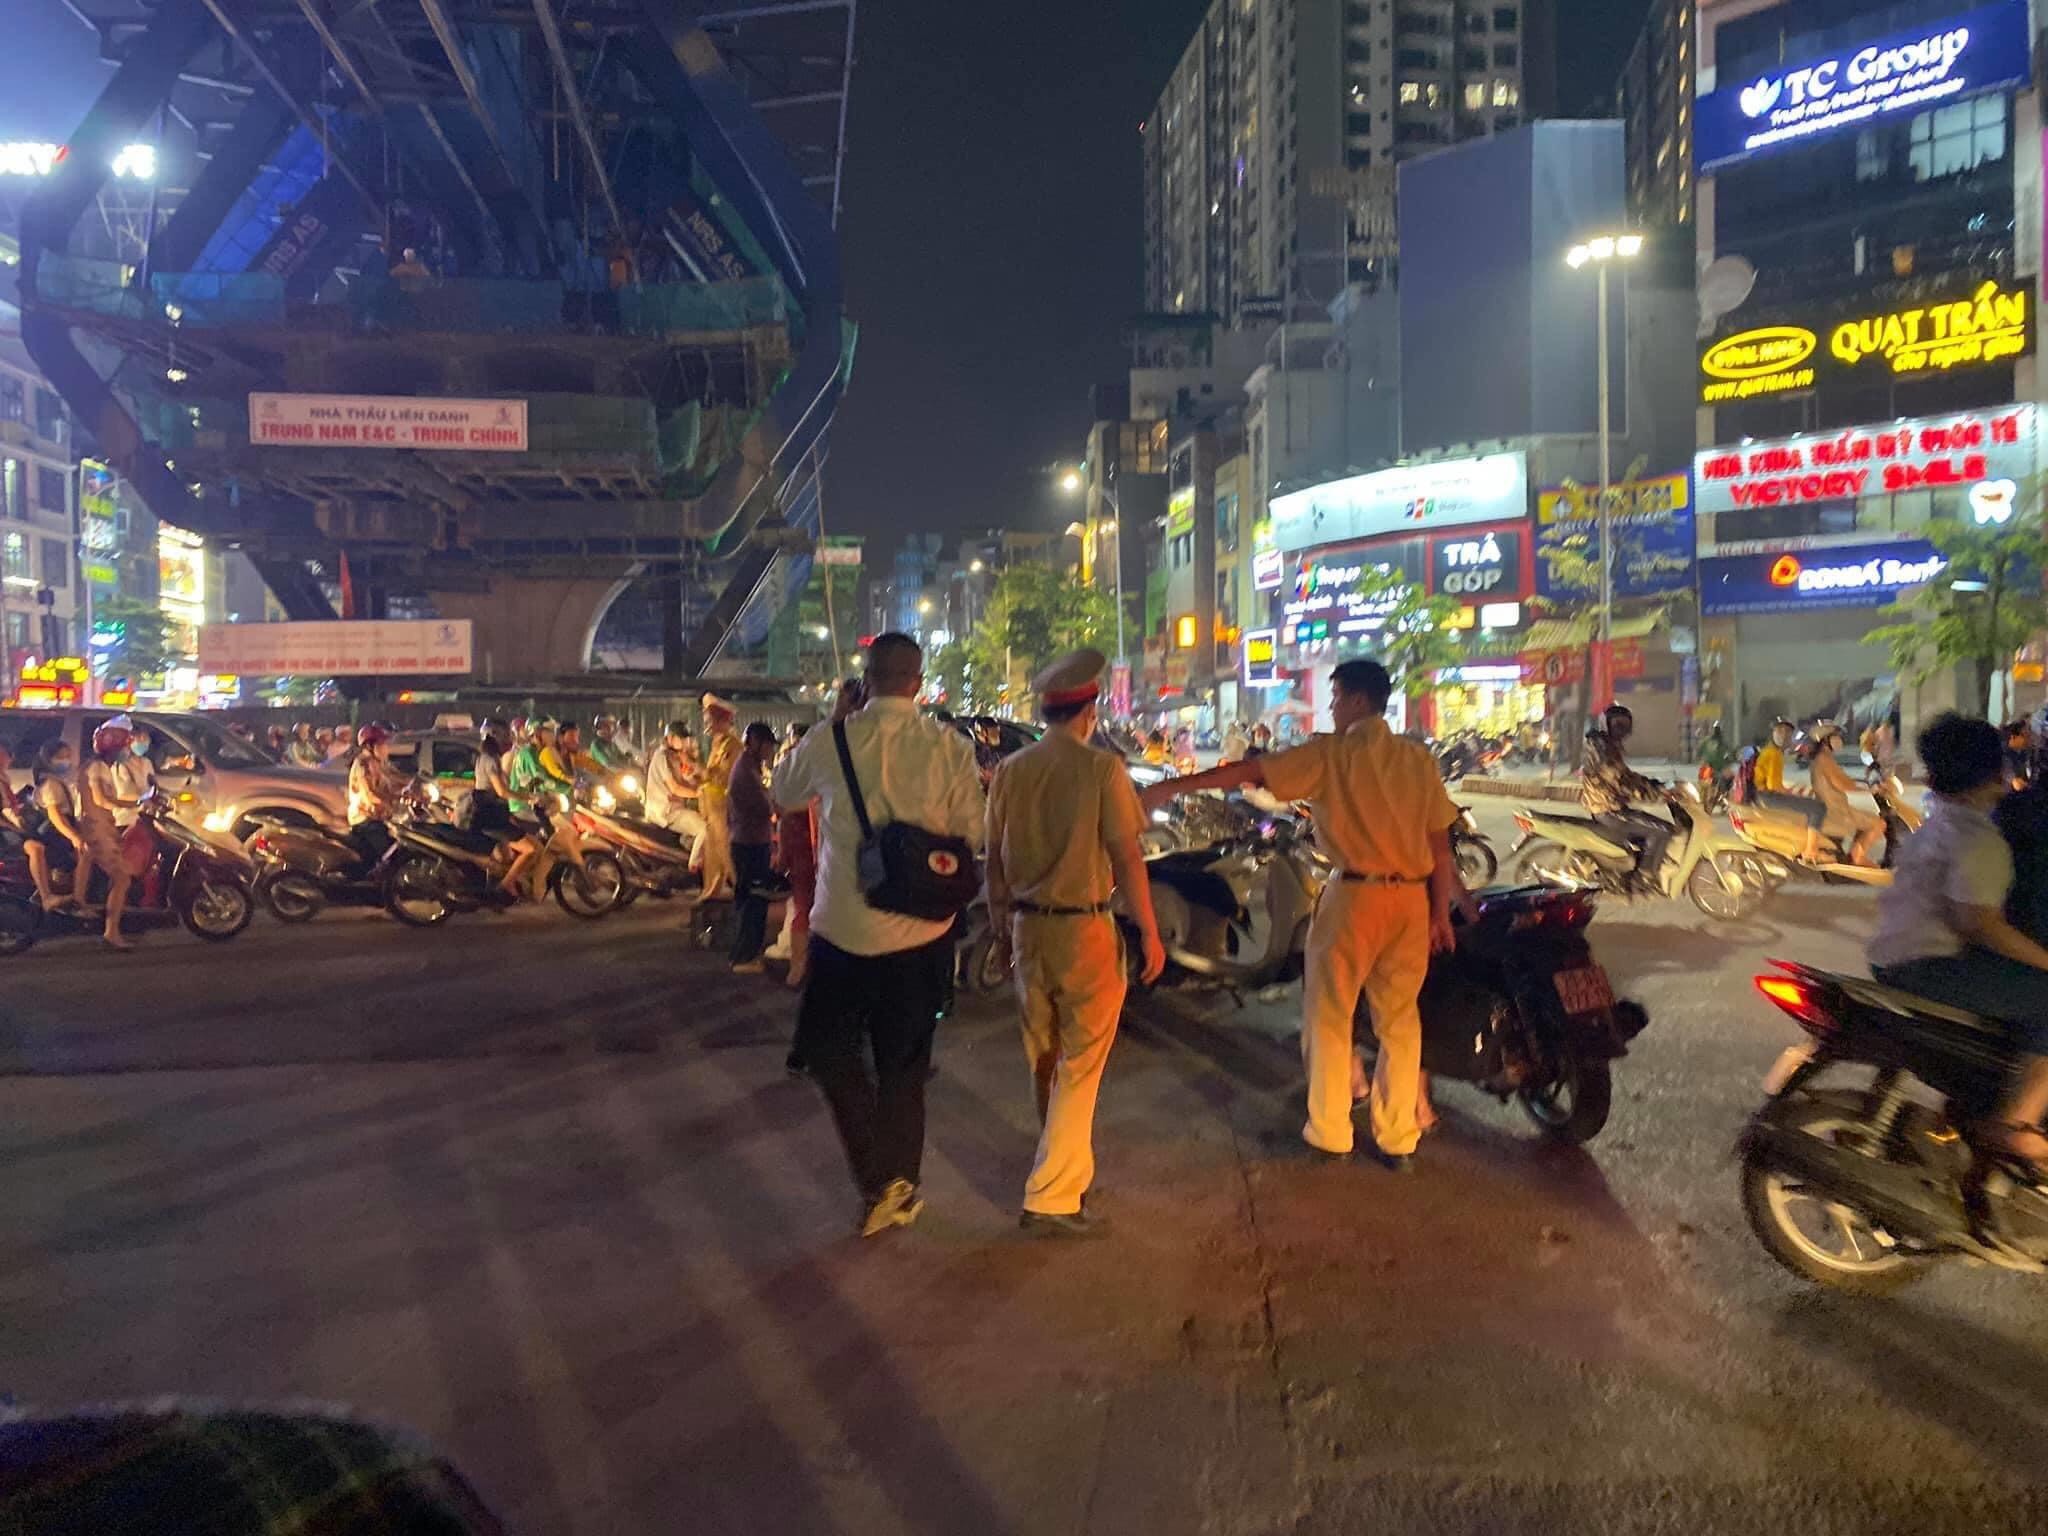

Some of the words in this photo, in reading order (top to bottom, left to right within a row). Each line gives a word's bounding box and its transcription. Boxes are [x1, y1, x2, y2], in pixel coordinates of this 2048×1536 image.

[1785, 60, 1838, 105] TC
[1847, 28, 1969, 85] Group
[428, 411, 470, 422] DANH
[260, 423, 313, 440] TRUNG
[319, 424, 356, 440] NAM
[362, 425, 396, 441] E&C
[412, 426, 465, 443] TRUNG
[470, 425, 519, 444] CHÍNH
[1730, 469, 1868, 507] VICTORY
[1443, 532, 1502, 566] TRẢ
[1444, 565, 1502, 593] GÓP
